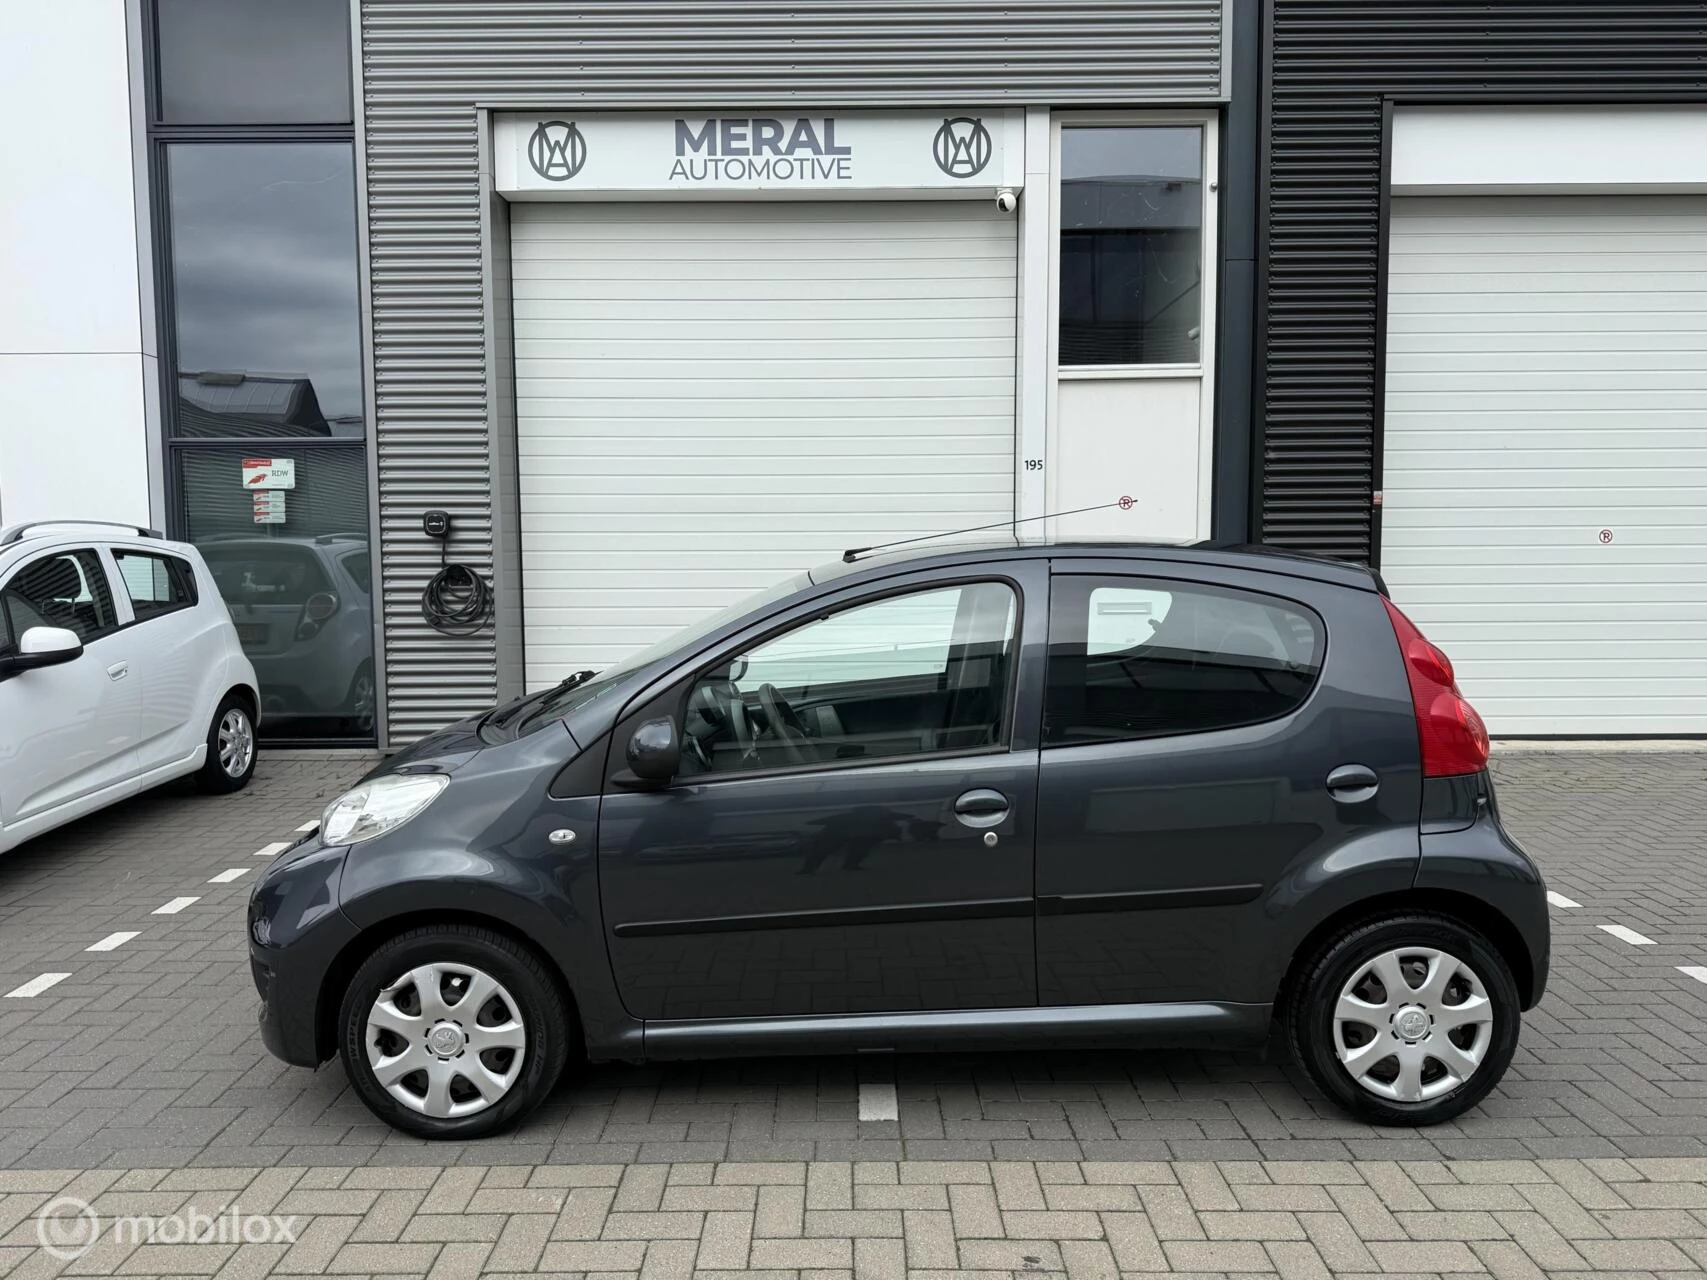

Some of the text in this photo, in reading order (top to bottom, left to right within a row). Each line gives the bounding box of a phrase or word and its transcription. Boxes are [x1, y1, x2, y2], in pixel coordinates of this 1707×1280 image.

[675, 118, 852, 156] MERAL
[669, 158, 852, 180] AUTOMOTIVE
[271, 469, 289, 477] RDW
[1024, 459, 1043, 471] 195
